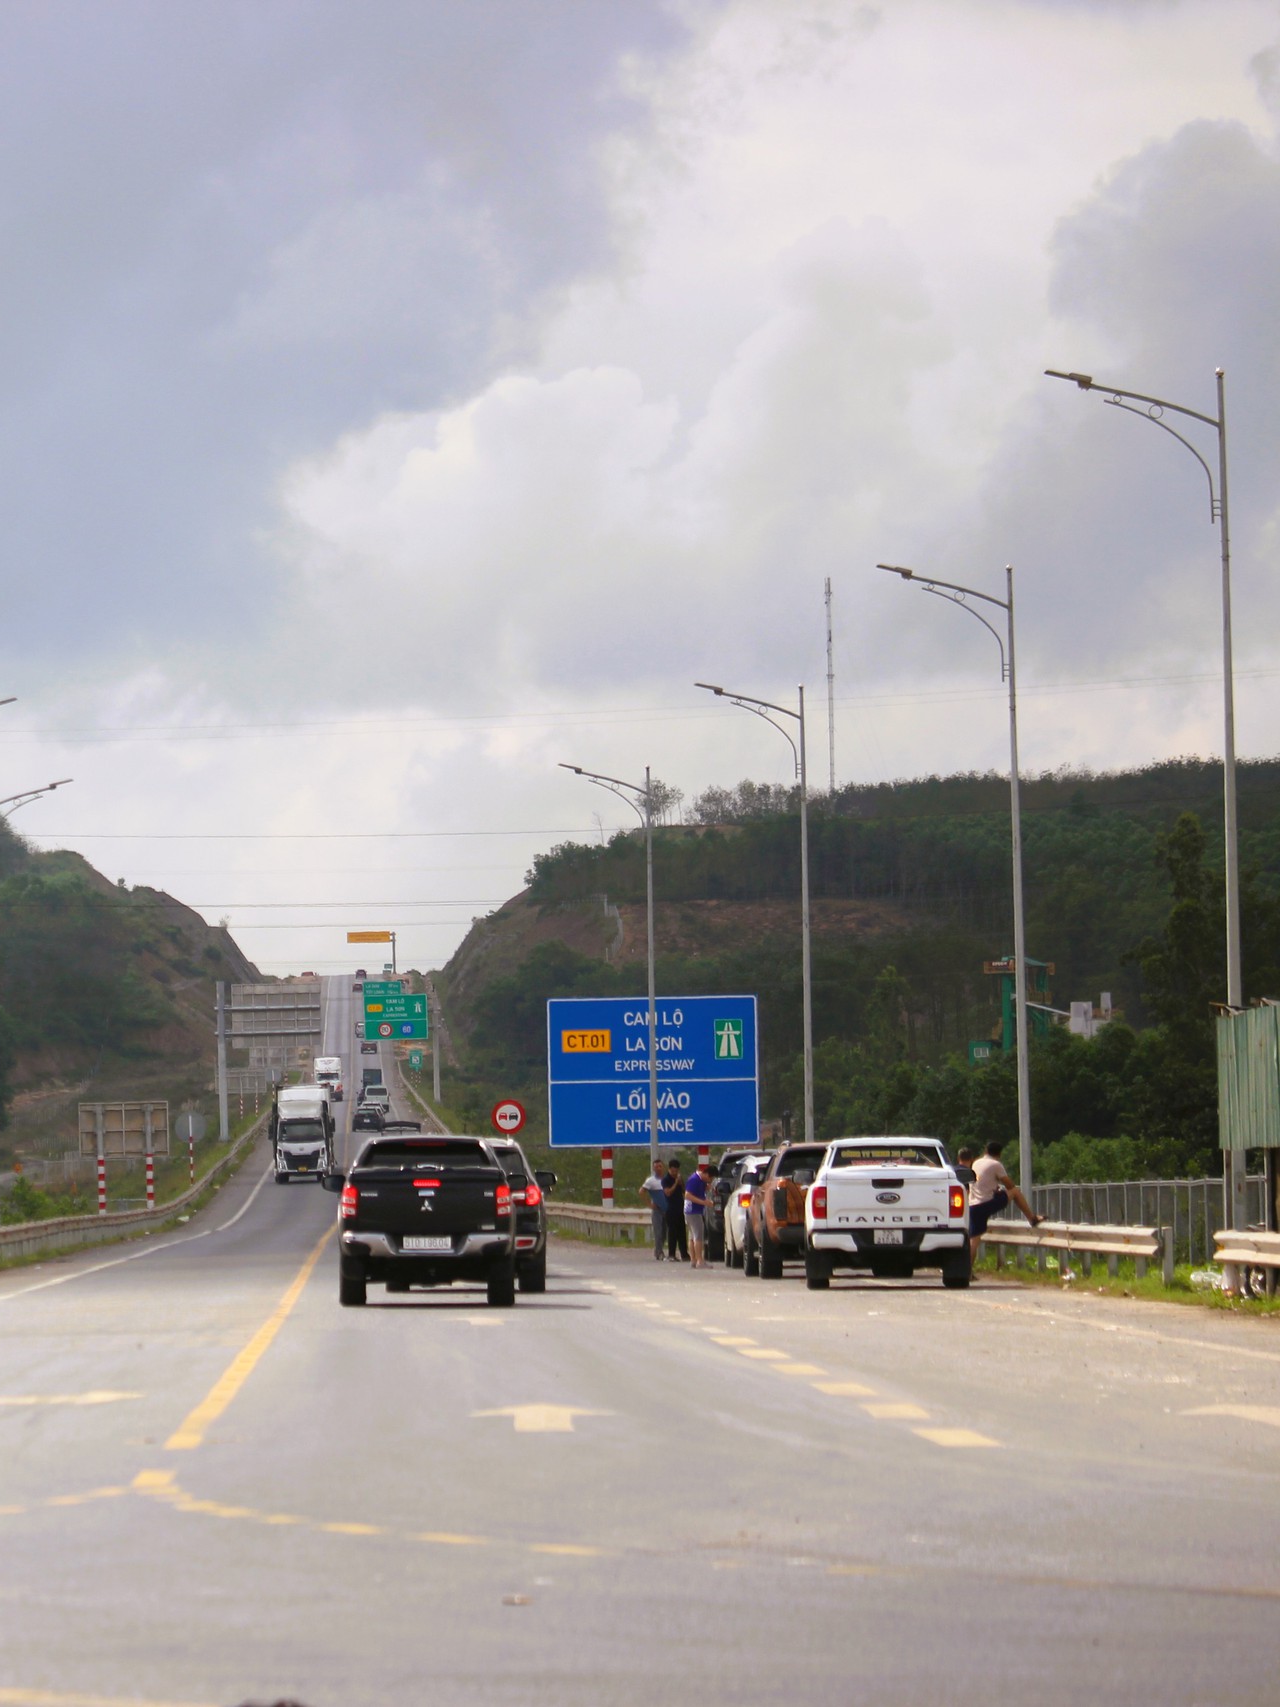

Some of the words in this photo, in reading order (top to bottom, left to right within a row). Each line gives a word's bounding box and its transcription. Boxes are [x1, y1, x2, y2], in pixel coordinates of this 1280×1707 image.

[663, 1008, 683, 1028] LỘ
[567, 1034, 605, 1048] CT.01
[625, 1037, 646, 1051] LA
[654, 1035, 682, 1051] SƠN
[616, 1087, 646, 1110] LỐI
[656, 1088, 690, 1109] VÀO
[615, 1119, 694, 1133] ENTRANCE
